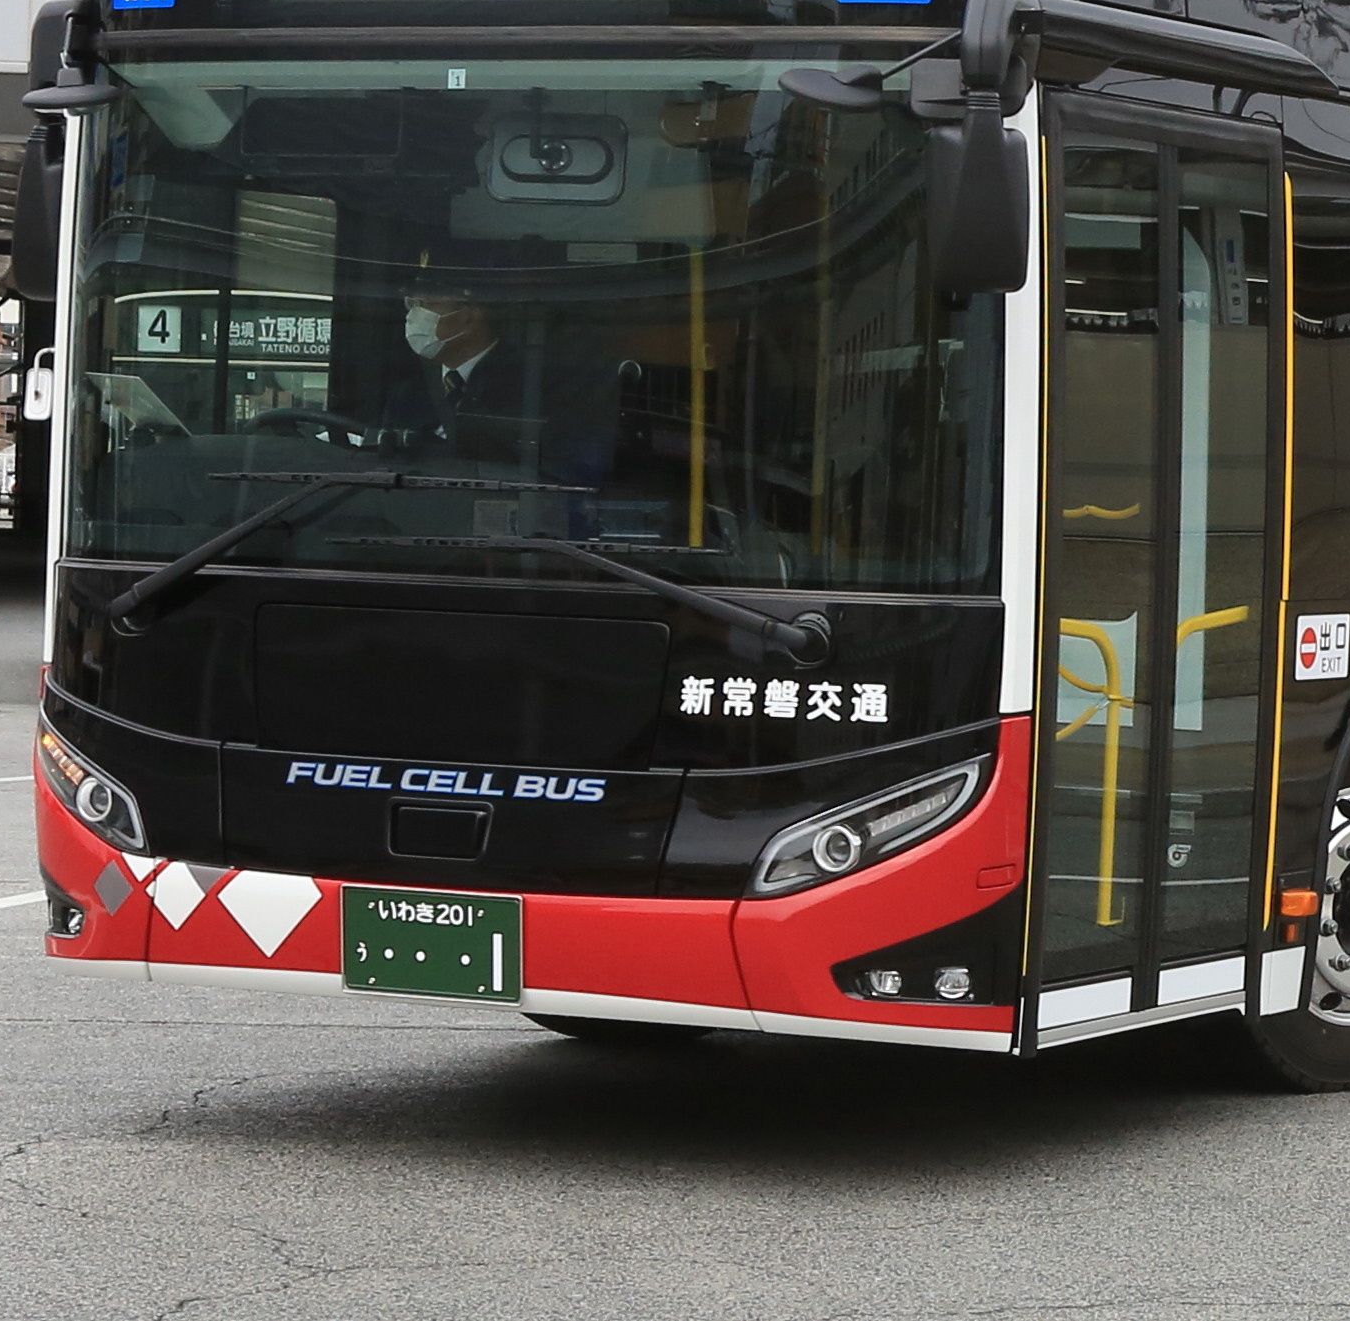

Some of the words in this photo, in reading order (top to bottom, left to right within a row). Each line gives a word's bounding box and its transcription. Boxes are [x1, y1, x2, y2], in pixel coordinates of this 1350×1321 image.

[148, 309, 170, 344] 4
[261, 343, 300, 354] TATENO
[1320, 622, 1347, 650] 出口
[1322, 657, 1341, 673] EXIT
[680, 676, 889, 723] 新常磐交通
[286, 761, 392, 789] FUEL
[400, 768, 504, 796] CELL
[513, 774, 607, 801] BUS
[378, 899, 473, 926] いわき201
